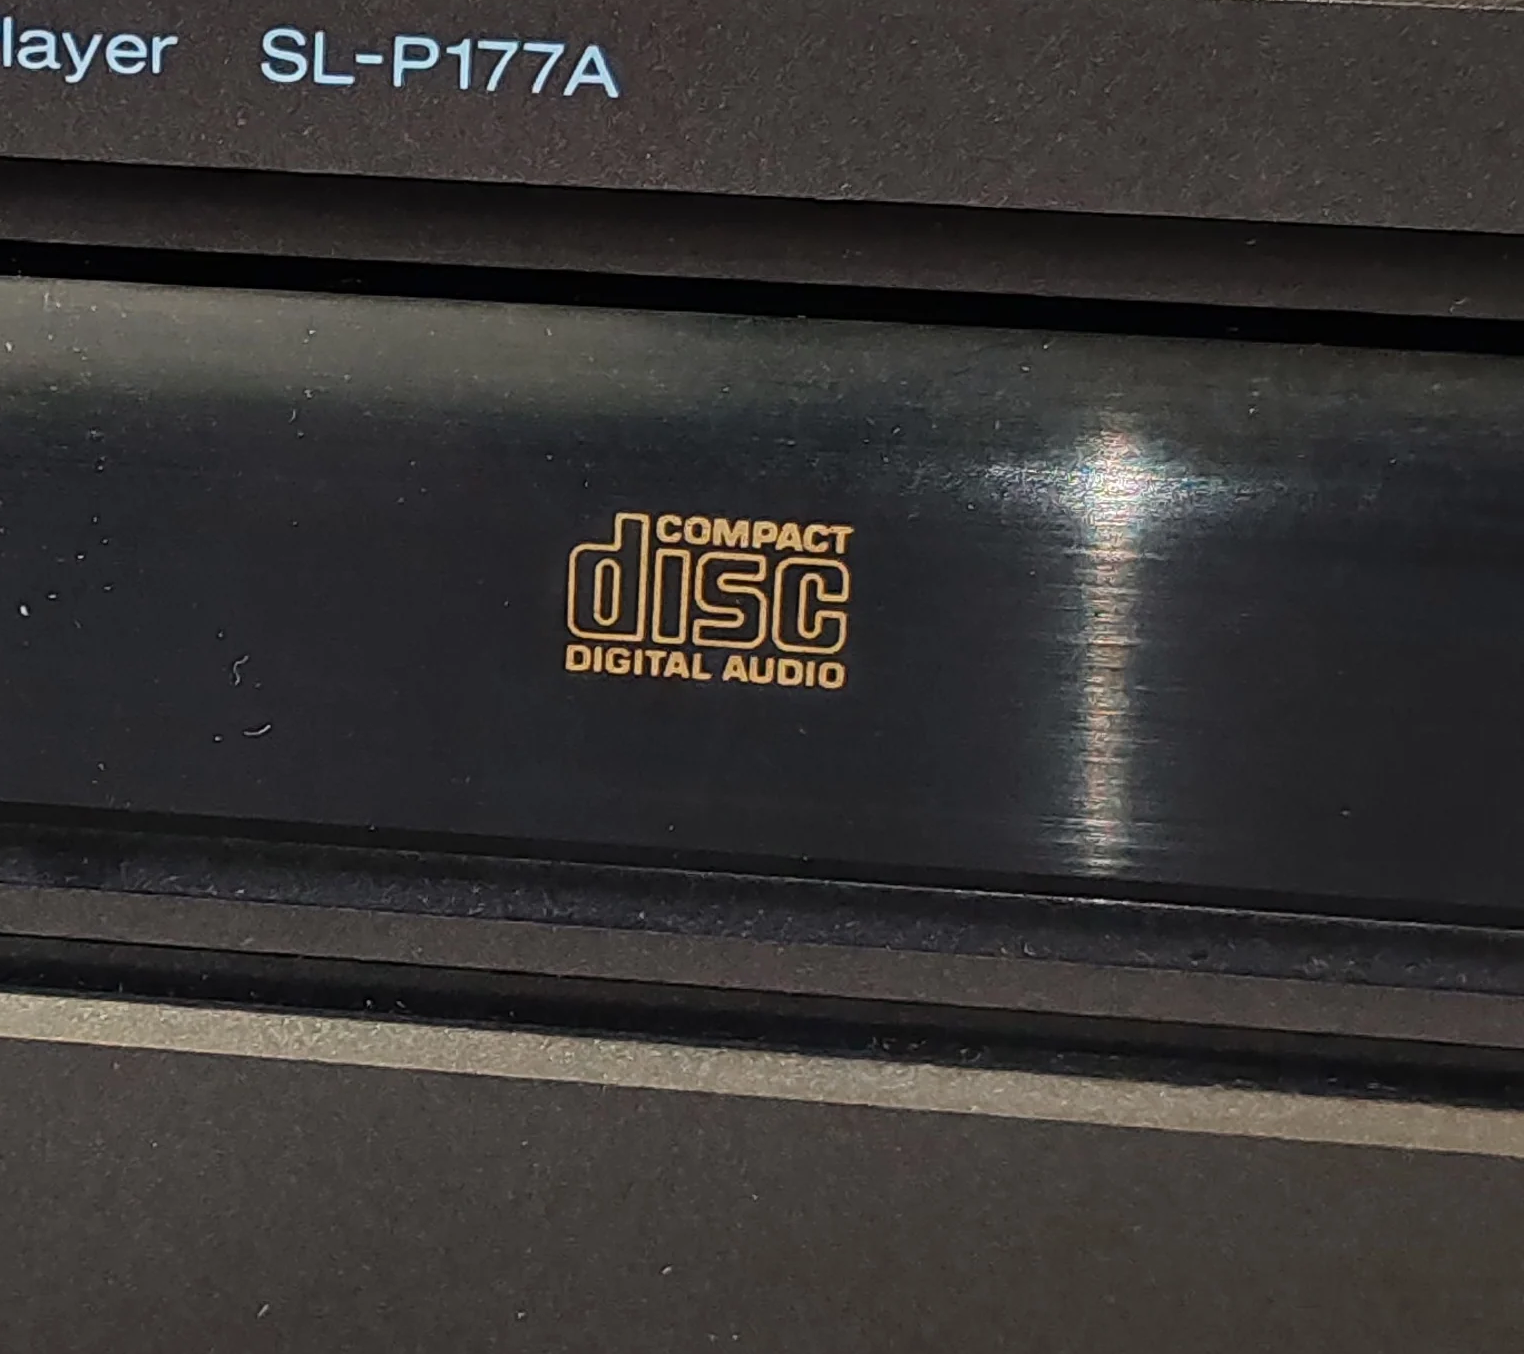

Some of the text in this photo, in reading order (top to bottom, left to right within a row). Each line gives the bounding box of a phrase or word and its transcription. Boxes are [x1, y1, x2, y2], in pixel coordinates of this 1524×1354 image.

[260, 28, 620, 99] SL-P177A
[655, 514, 854, 555] COMPACT
[565, 644, 847, 689] DIGITAL AUDIO
